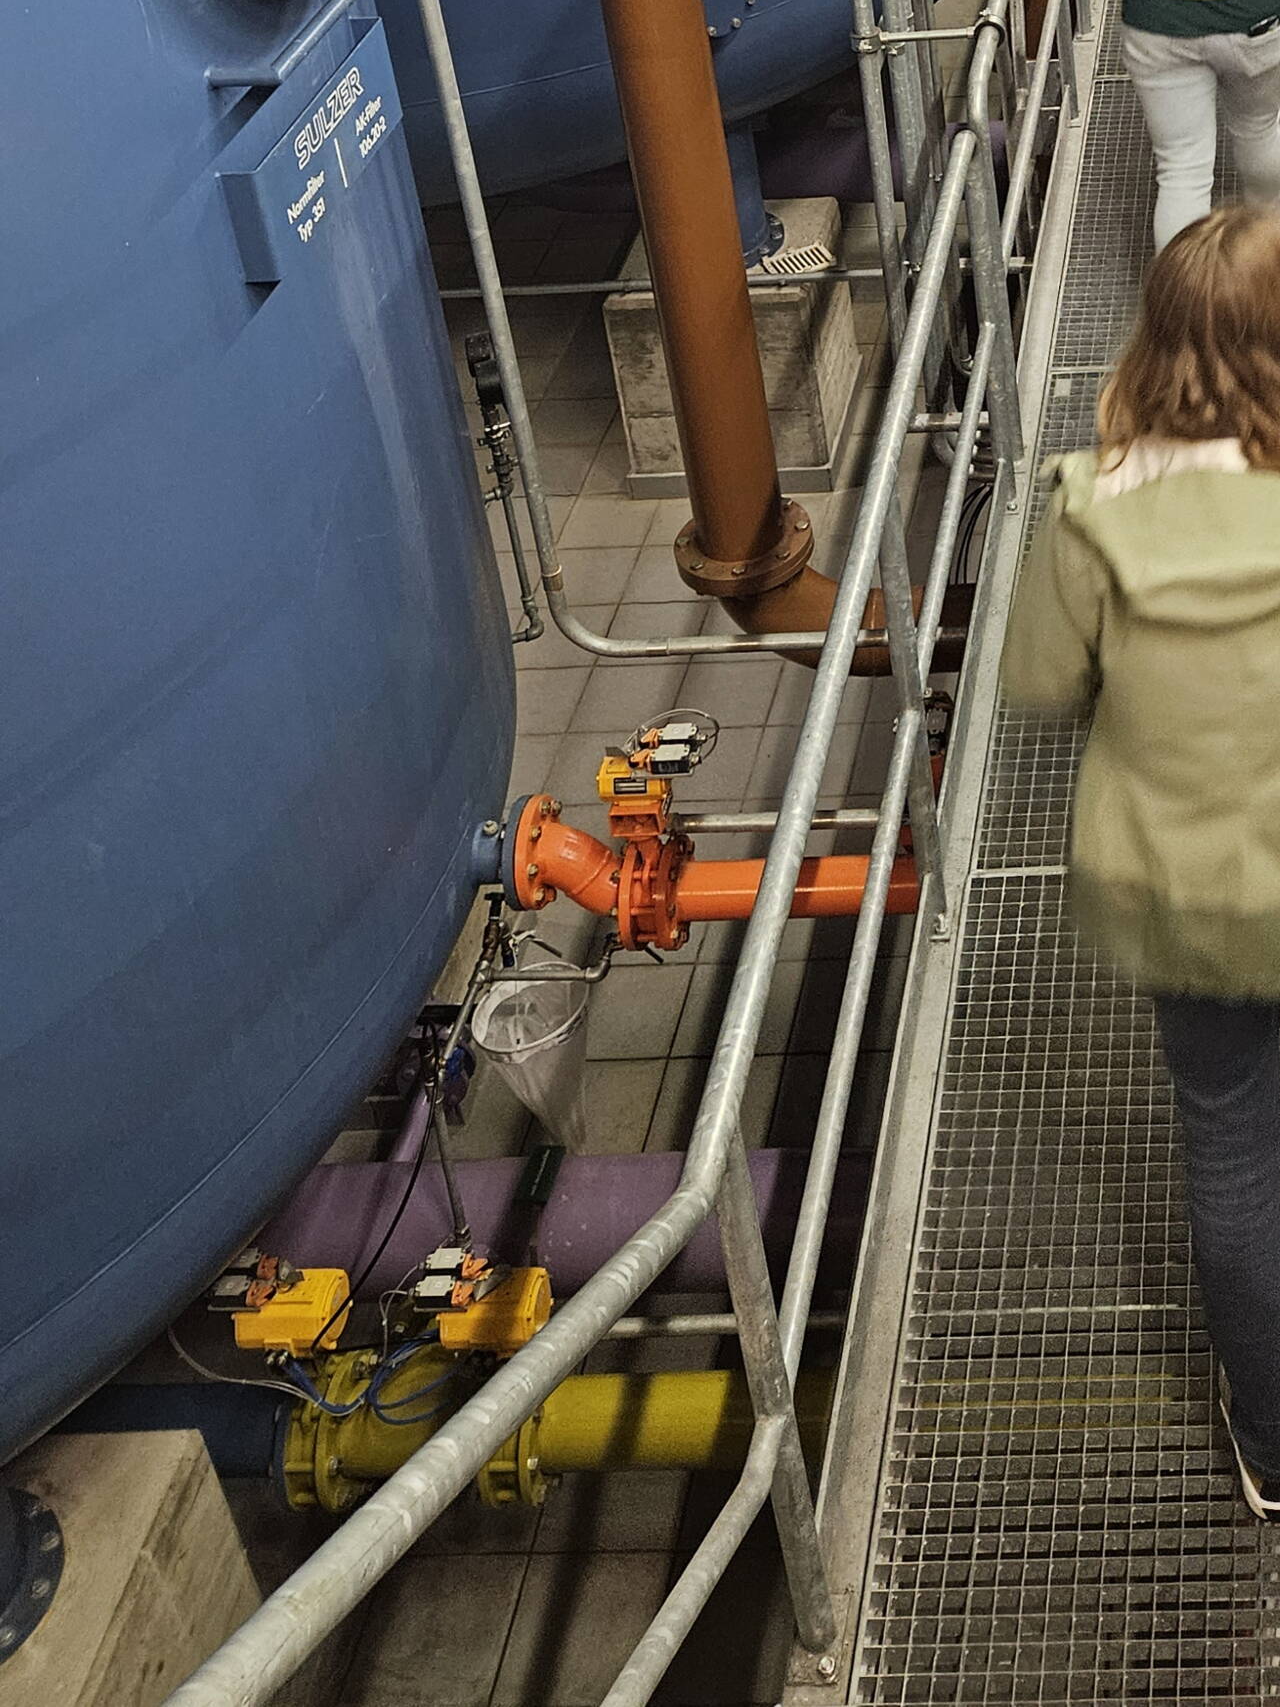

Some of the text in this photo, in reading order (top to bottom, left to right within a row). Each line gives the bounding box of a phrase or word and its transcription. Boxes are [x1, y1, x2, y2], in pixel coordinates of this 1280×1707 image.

[293, 66, 365, 170] SULZER
[354, 95, 383, 137] AK-Filter
[286, 170, 326, 225] Normfilter
[296, 197, 327, 243] Typ 351
